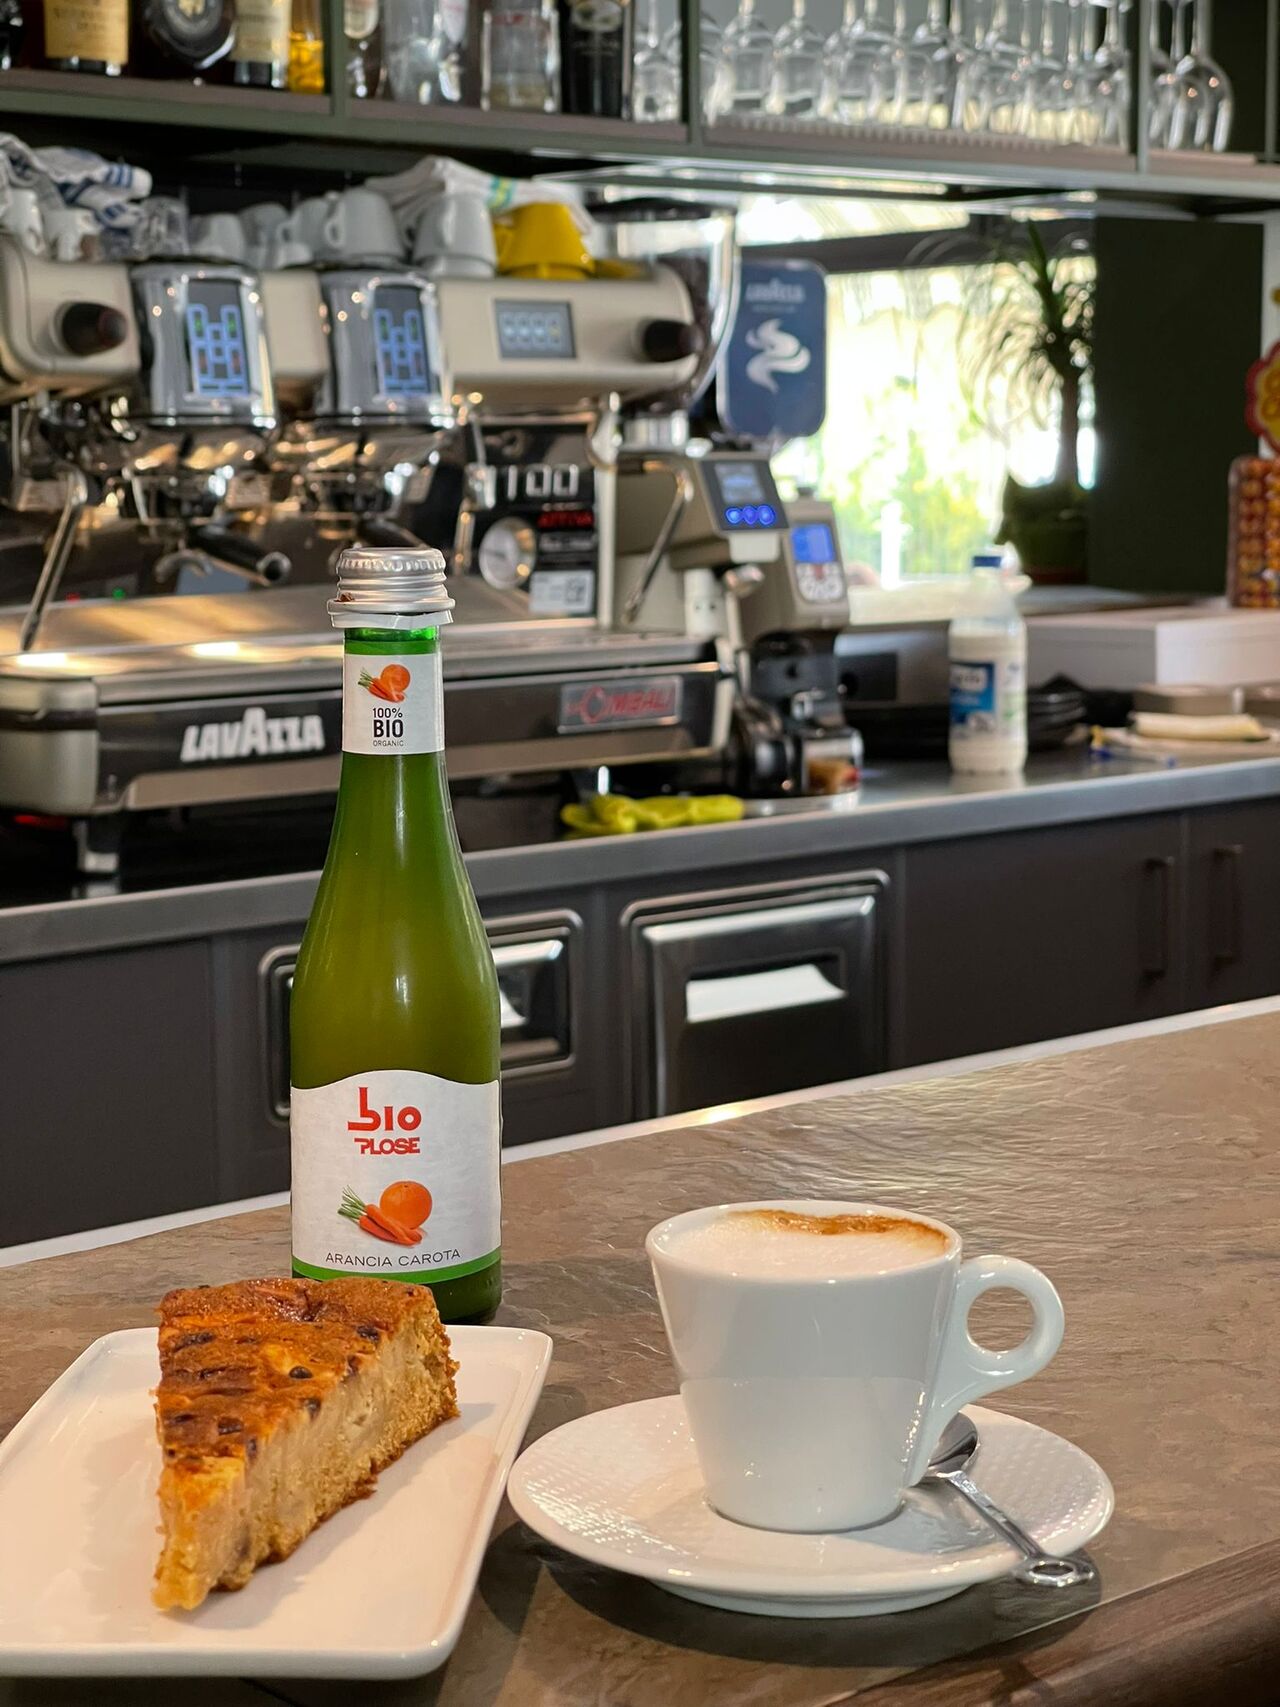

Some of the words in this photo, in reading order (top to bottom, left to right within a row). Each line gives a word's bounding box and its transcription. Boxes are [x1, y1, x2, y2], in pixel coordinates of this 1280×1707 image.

[372, 707, 403, 719] 100%
[180, 707, 326, 763] LAVAZZA
[373, 719, 404, 738] BIO
[347, 1086, 422, 1131] bio
[354, 1137, 421, 1155] PLOSE
[325, 1252, 393, 1267] ARANCIA
[398, 1248, 461, 1266] CAROTA
